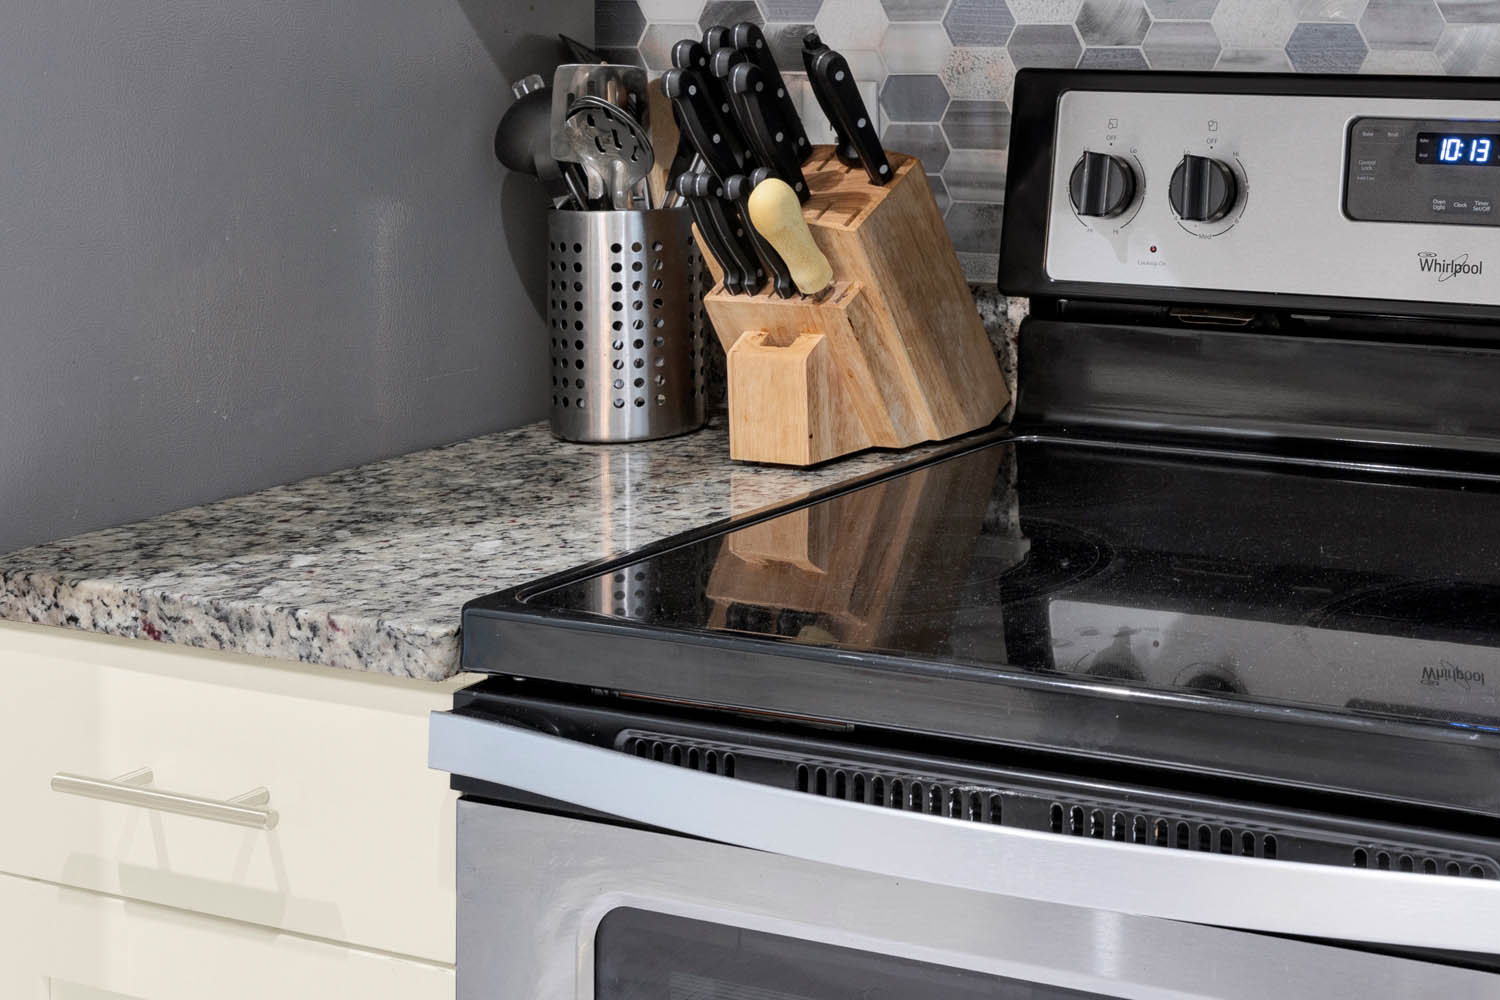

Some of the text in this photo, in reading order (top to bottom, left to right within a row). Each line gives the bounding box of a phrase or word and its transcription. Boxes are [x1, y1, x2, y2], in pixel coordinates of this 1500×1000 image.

[1129, 146, 1138, 154] Lo
[1440, 138, 1491, 162] 10:13
[1418, 256, 1483, 279] Whirlpool
